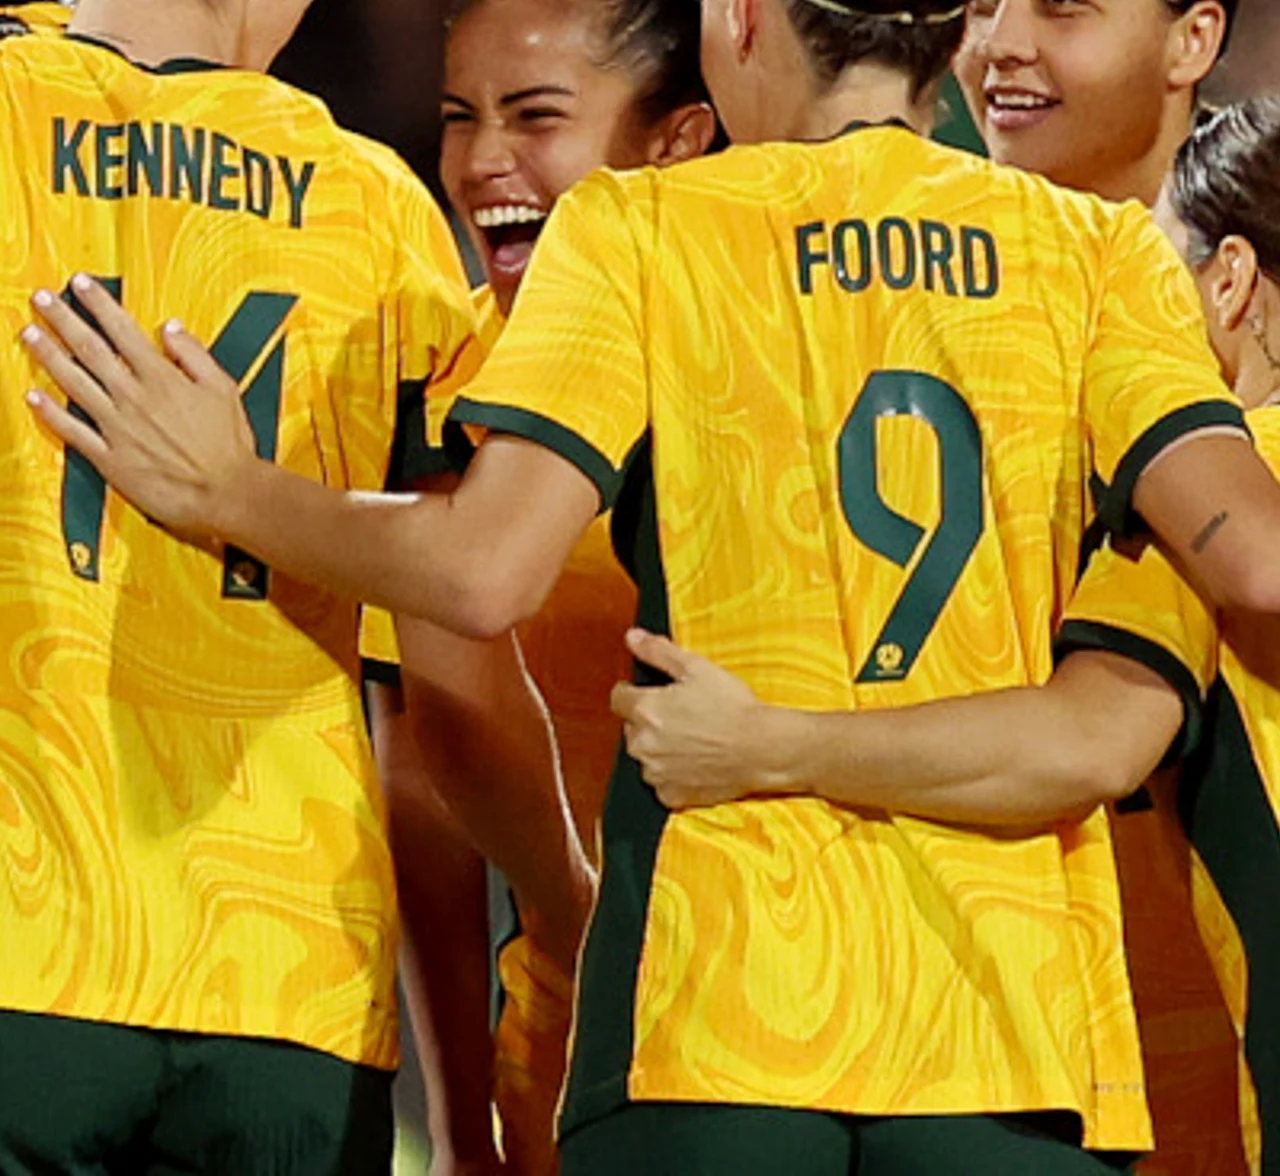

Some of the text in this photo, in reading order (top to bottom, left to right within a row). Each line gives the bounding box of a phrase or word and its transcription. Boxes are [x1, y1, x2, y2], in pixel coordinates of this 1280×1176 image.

[51, 116, 317, 230] KENNEDY
[794, 216, 1001, 300] FOORD
[836, 368, 985, 684] 9
